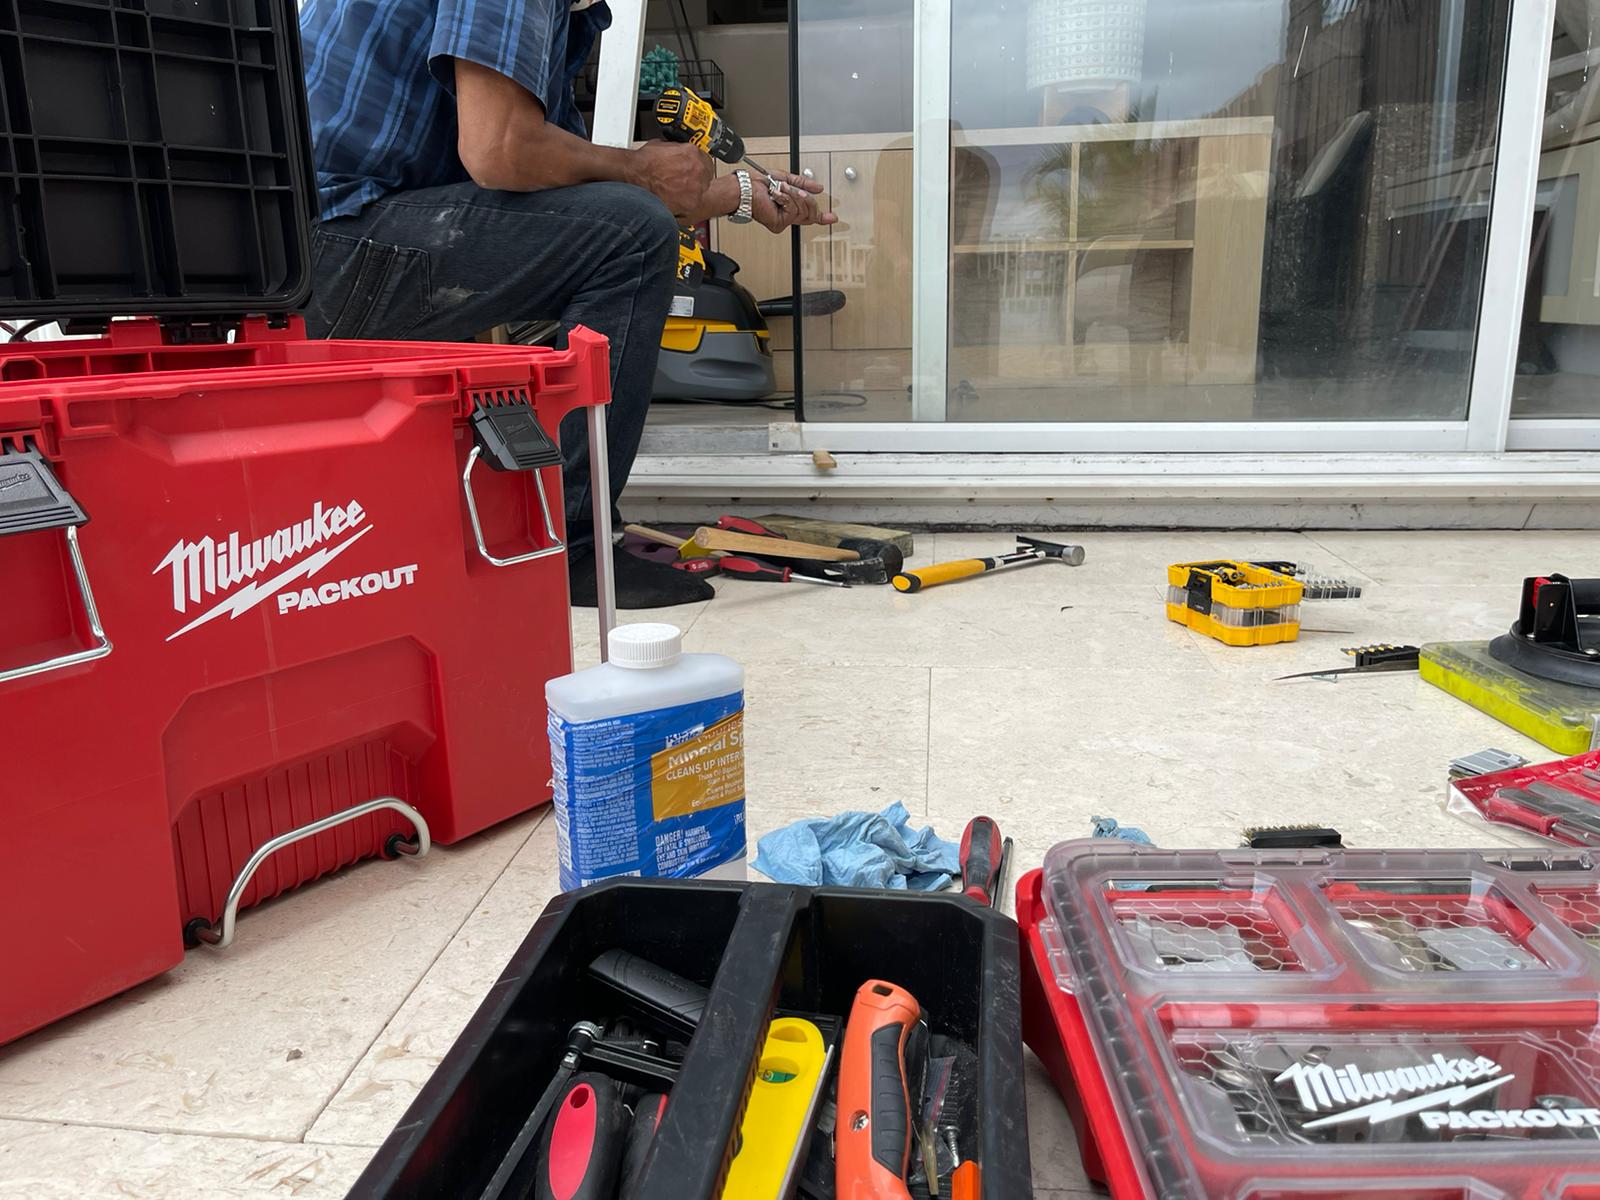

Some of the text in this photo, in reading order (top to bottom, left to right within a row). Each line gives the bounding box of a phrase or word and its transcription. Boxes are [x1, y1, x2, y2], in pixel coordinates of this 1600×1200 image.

[152, 499, 366, 613] Milwaukee
[277, 564, 418, 615] PACKOUT
[668, 734, 726, 769] Mineral
[666, 763, 702, 781] CLEANS
[703, 758, 716, 771] UP
[655, 828, 684, 847] DANGER!
[1274, 1053, 1502, 1111] Milwaukee
[1420, 1107, 1600, 1129] PACKOUT
